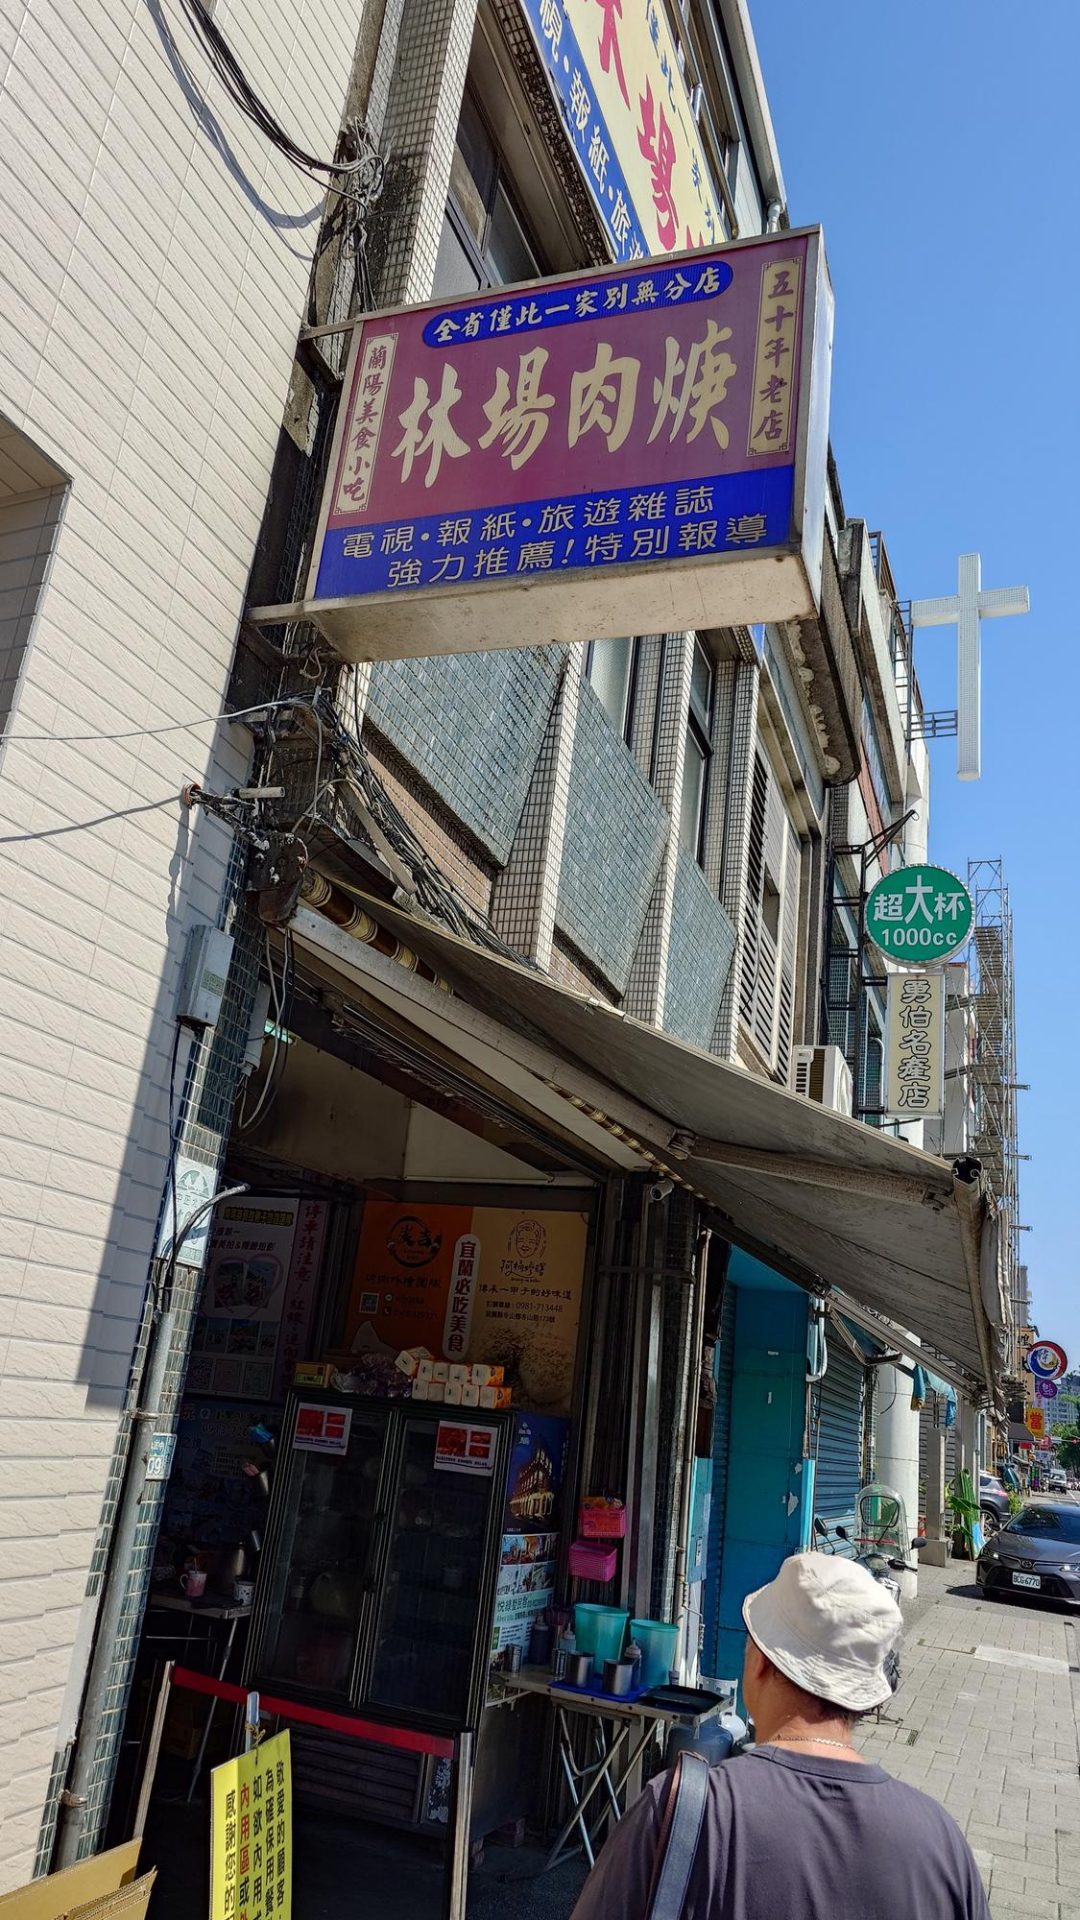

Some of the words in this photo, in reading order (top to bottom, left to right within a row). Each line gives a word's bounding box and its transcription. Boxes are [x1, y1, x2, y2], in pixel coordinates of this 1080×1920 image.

[433, 267, 720, 343] 全省僅此一家別無分店
[753, 271, 795, 441] 五十年老店
[343, 345, 388, 502] 蘭陽美食小吃
[873, 874, 965, 925] 超大杯
[881, 928, 957, 946] 1000cc
[898, 979, 932, 1109] 勇伯名產店
[448, 1240, 476, 1353] 宜蘭必吃美食
[224, 1790, 236, 1920] 感謝您的
[265, 1767, 275, 1920] 為確保用餐
